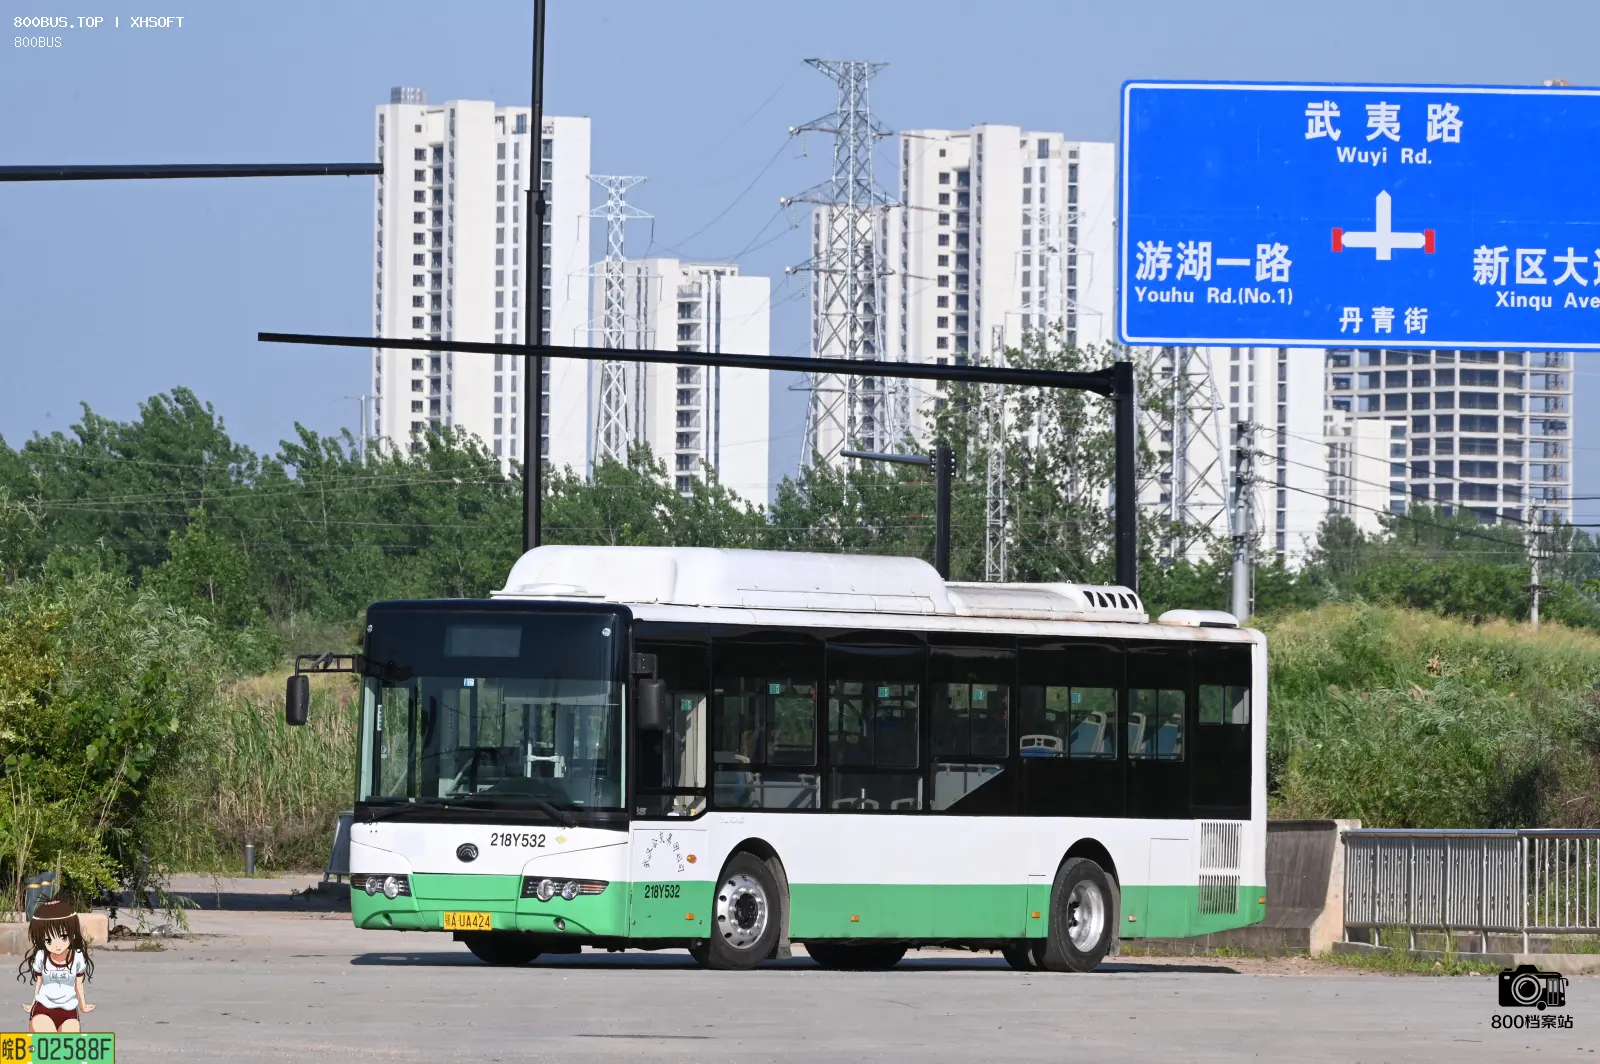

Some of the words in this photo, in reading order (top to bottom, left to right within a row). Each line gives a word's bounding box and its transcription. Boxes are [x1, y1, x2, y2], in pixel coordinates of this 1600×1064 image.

[1304, 100, 1464, 143] 武夷路
[1336, 146, 1388, 167] Wuyi
[1400, 147, 1433, 165] Rd.
[1135, 240, 1293, 283] 游湖一路
[1472, 244, 1600, 287] 新区大
[1134, 286, 1195, 303] Youhu
[1206, 287, 1293, 305] Rd.(No.1)
[1495, 290, 1553, 312] Xinqu
[1563, 292, 1600, 309] Ave
[1338, 305, 1429, 335] 丹青街
[490, 832, 547, 848] 218Y532
[644, 884, 681, 899] 218Y532
